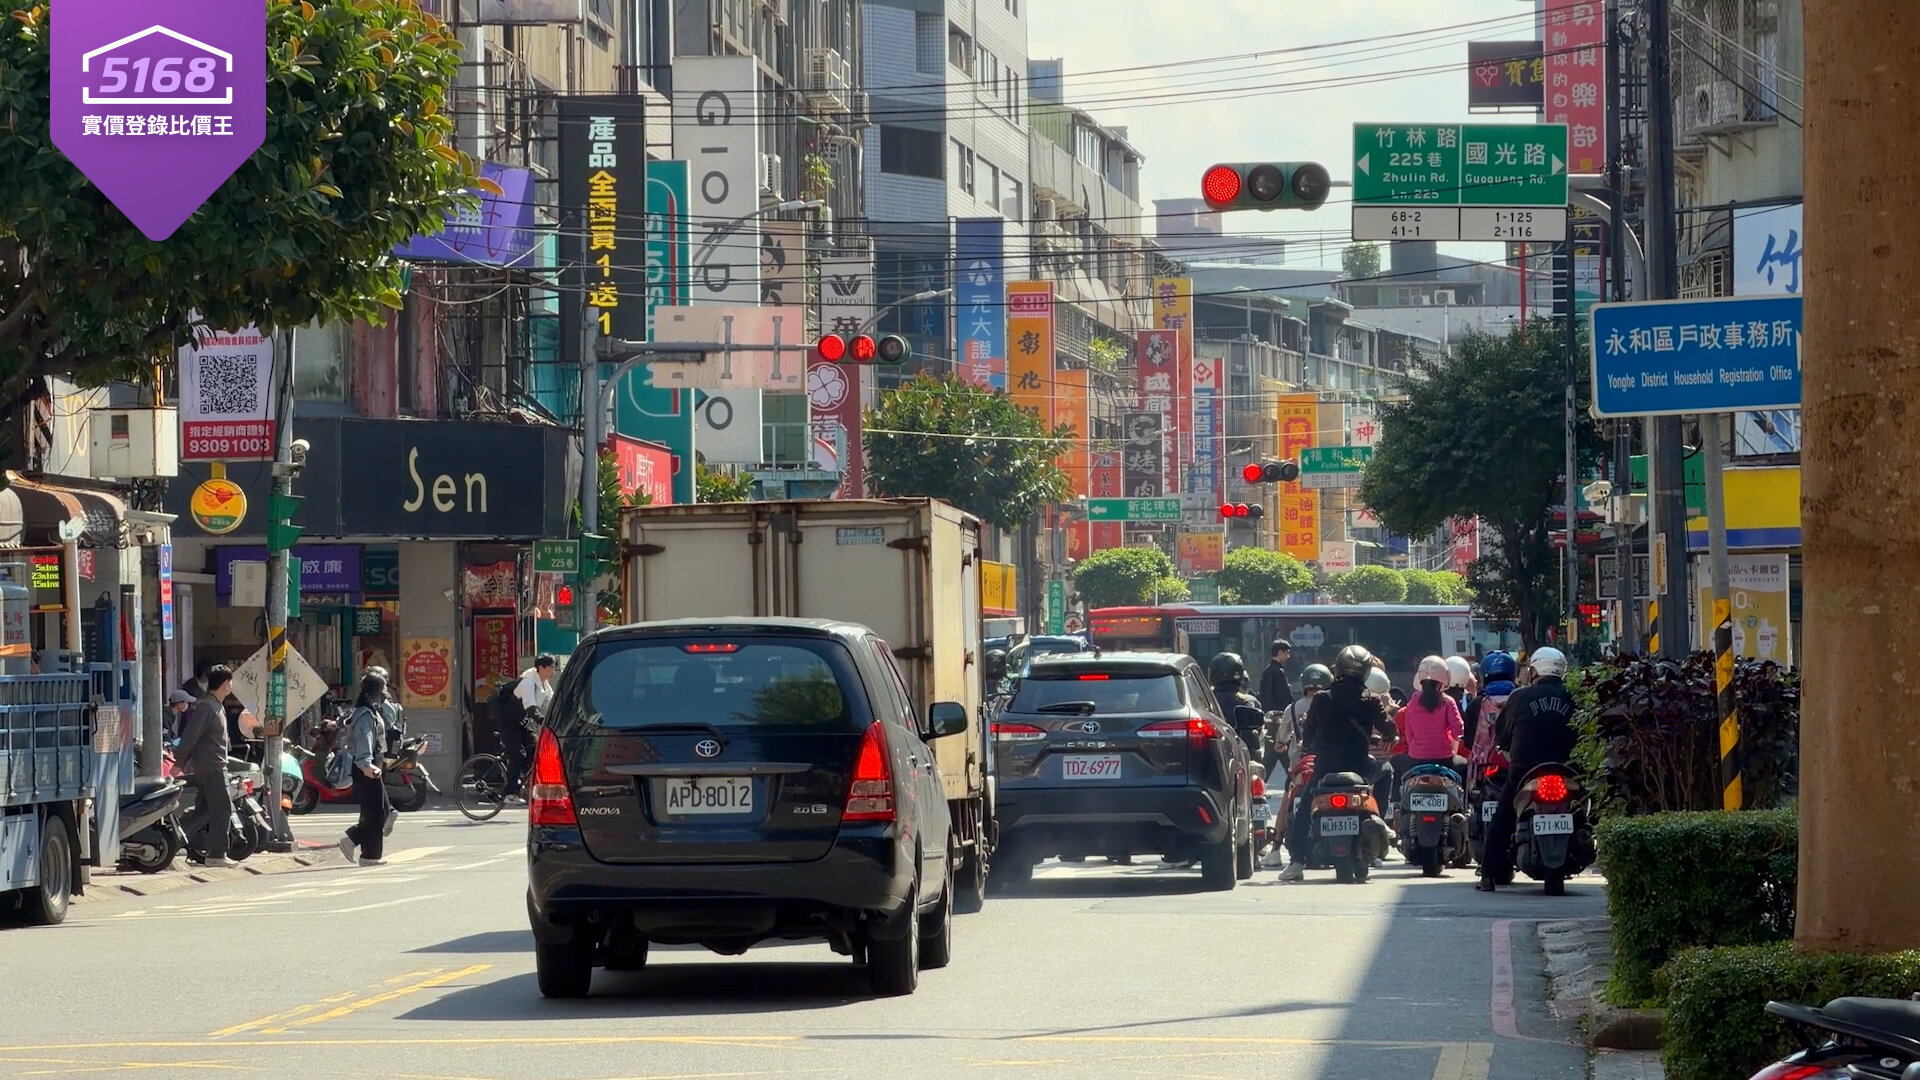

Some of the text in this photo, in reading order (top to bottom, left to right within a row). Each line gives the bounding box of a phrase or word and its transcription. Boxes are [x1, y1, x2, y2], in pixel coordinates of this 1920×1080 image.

[1376, 128, 1457, 149] 竹林路
[1389, 152, 1442, 168] 225巷
[1466, 142, 1546, 166] 國光路
[1383, 173, 1449, 182] Zhulin Rd.
[1530, 174, 1547, 184] Rd.
[1414, 189, 1439, 199] 225
[1391, 212, 1421, 222] 68-2
[1495, 213, 1533, 223] 1-125
[1391, 227, 1420, 237] 41-1
[1494, 227, 1533, 238] 2-116
[696, 90, 733, 431] GIORDO
[1011, 294, 1048, 312] CHB
[971, 295, 992, 382] 元大證券
[1604, 319, 1793, 357] 永和區戶政事務所
[1608, 366, 1792, 392] Yonghe District Household Registration Office
[1355, 422, 1376, 444] 神
[189, 439, 270, 453] 93091003
[403, 446, 487, 513] Sen
[1128, 500, 1178, 511] 新北環快
[544, 545, 574, 554] 竹林路
[302, 560, 343, 574] 威廉
[551, 558, 575, 568] 225巷
[31, 572, 59, 580] 23mins
[357, 611, 380, 633] 藥
[1065, 761, 1120, 775] TDZ-6977
[669, 785, 750, 808] APD-8012
[580, 807, 620, 815] INNOVA
[1535, 822, 1572, 832] 571-KUL
